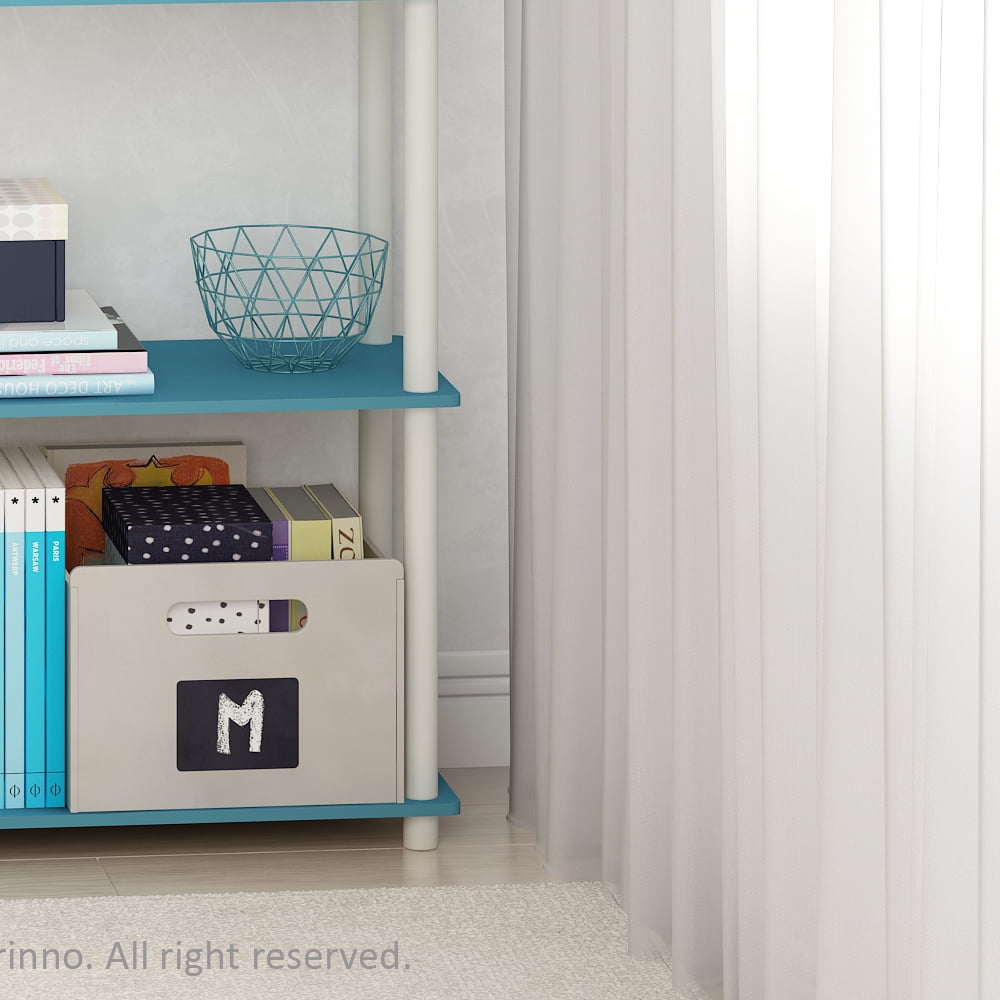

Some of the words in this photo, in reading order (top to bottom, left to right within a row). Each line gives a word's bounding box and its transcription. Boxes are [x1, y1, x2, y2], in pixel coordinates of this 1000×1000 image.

[43, 335, 89, 348] space
[47, 381, 89, 396] DECO
[92, 380, 122, 394] ART
[31, 541, 40, 573] WARSAW
[52, 540, 60, 562] PARIS
[216, 689, 264, 755] M
